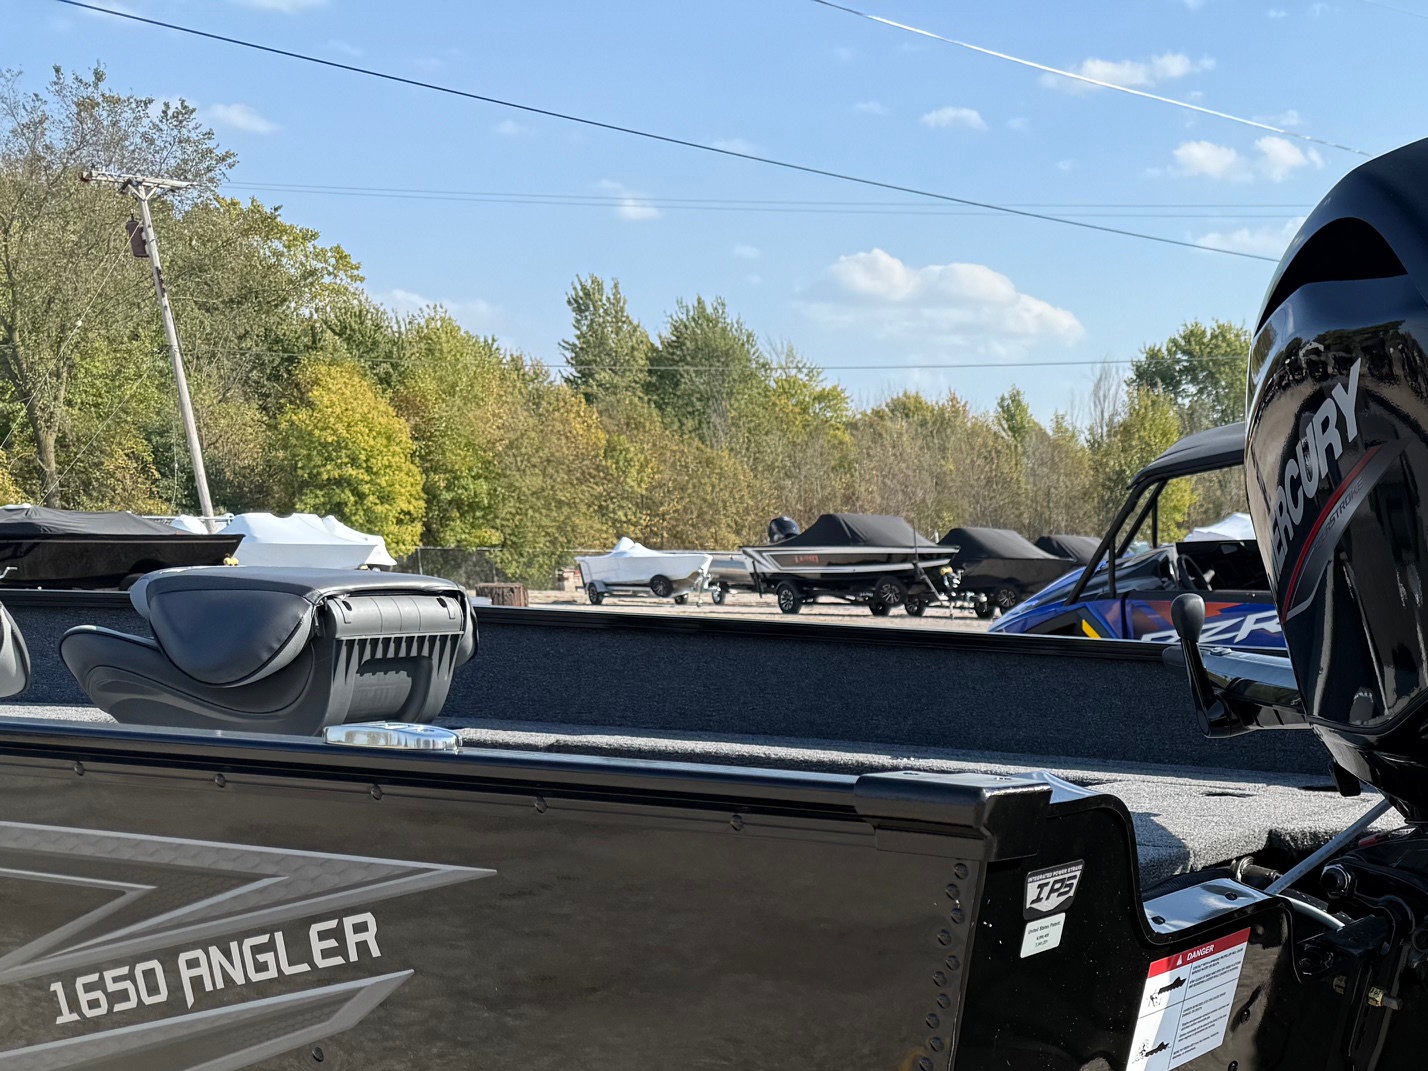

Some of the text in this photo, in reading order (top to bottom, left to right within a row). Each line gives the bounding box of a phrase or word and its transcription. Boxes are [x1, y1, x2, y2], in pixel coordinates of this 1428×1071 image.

[1030, 874, 1079, 905] IPS
[50, 912, 381, 1024] 1650 ANGLER
[1187, 944, 1215, 961] DANGER
